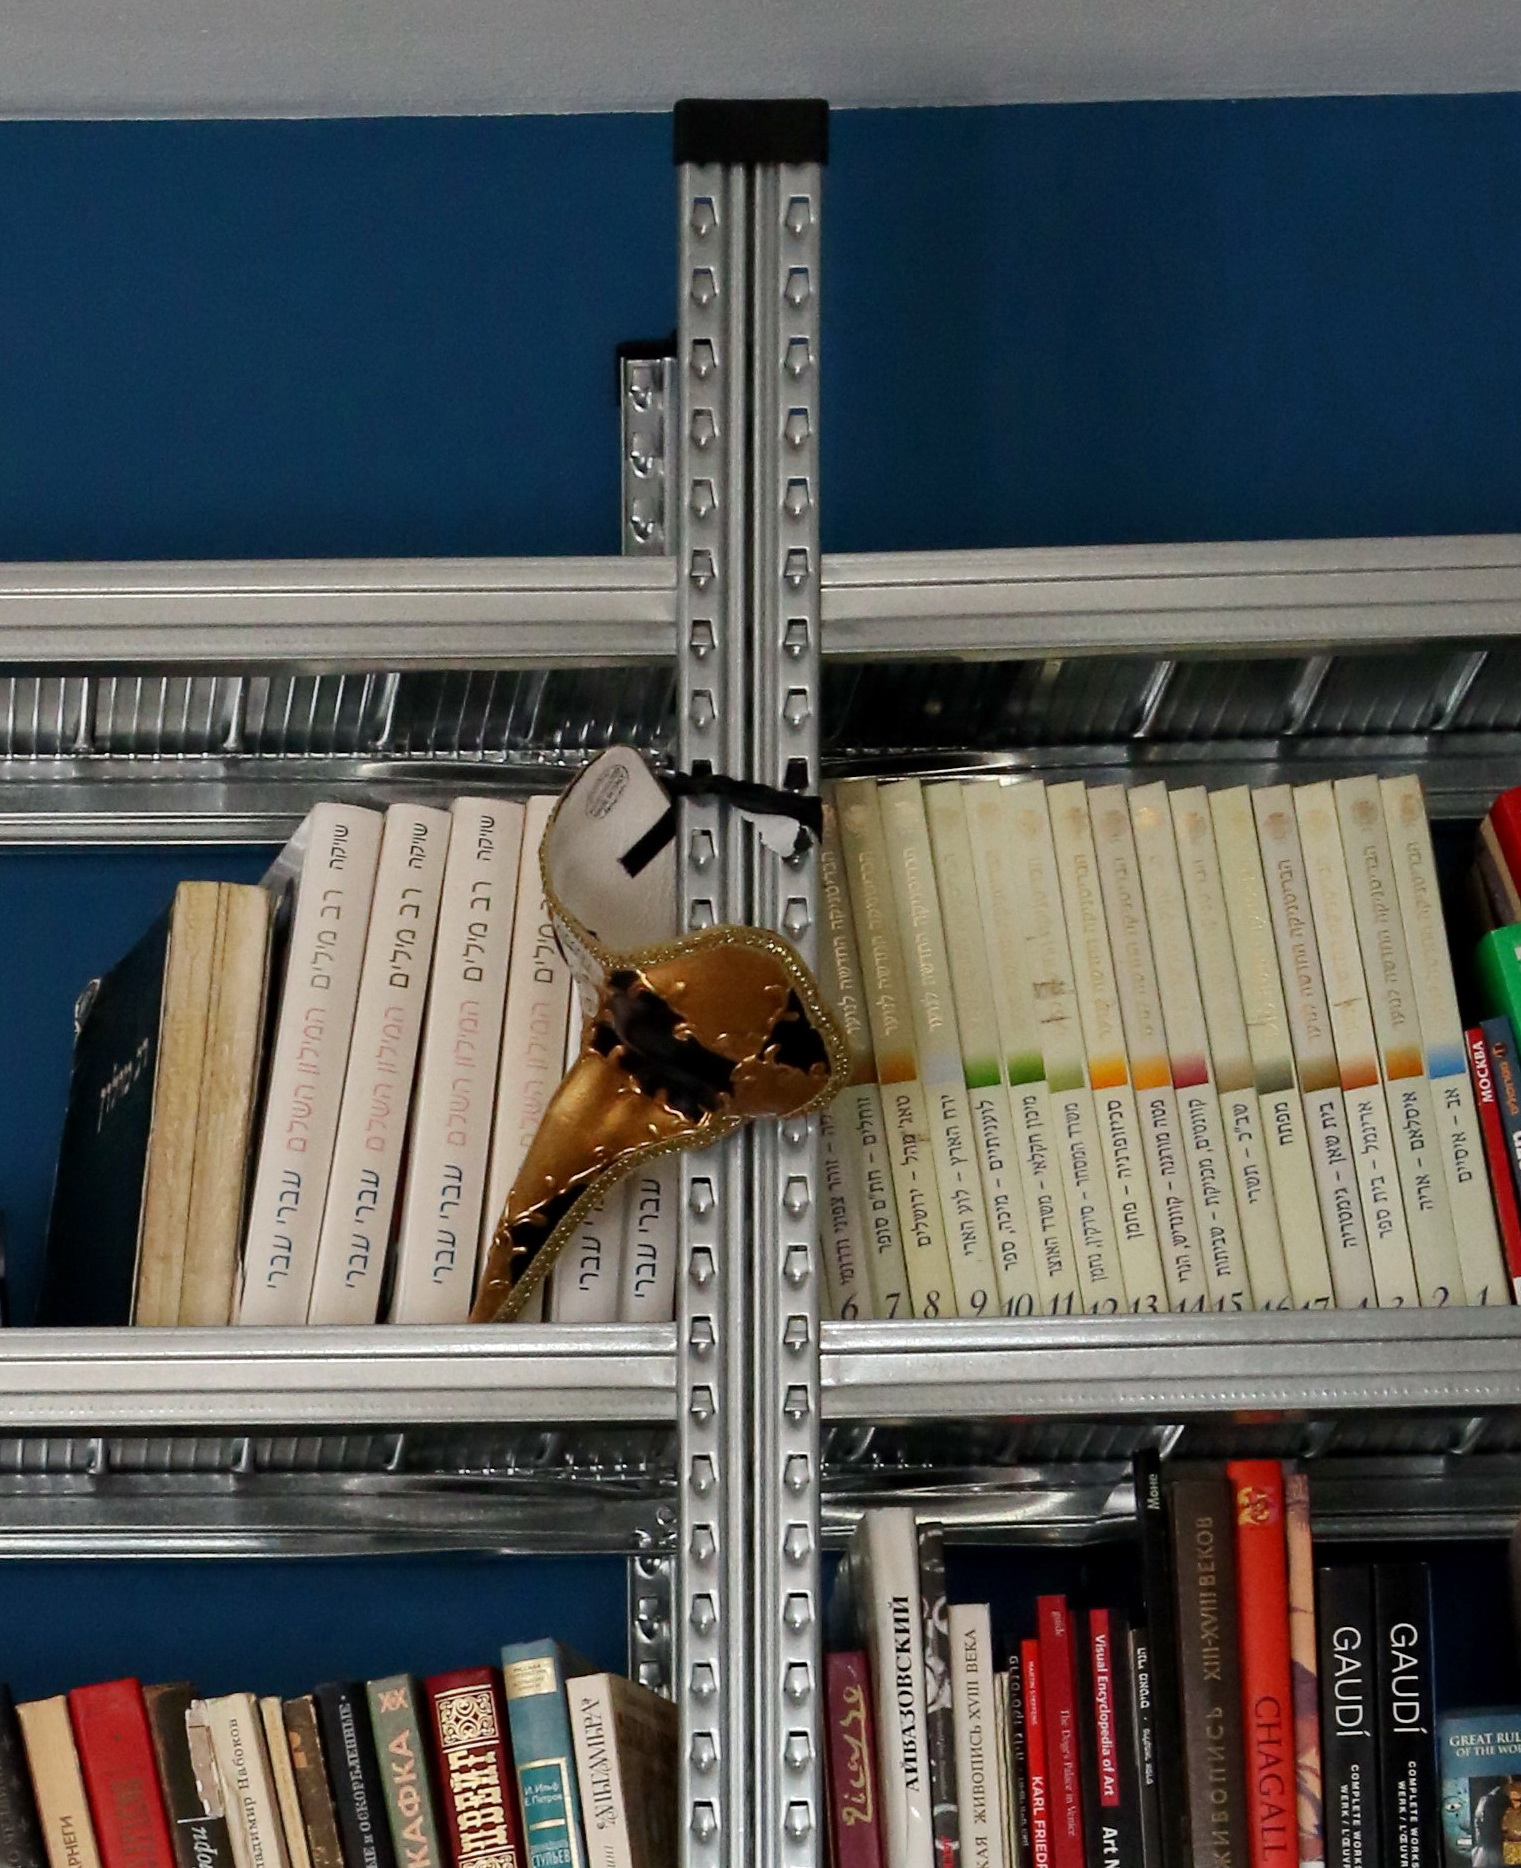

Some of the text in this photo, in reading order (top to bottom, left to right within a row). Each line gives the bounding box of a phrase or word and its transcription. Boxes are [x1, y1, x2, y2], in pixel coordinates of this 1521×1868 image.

[344, 888, 422, 1288] רב מילים המילון השלם עברי עברי
[433, 881, 493, 1284] רב מילים המילון השלם עברי עברי
[1446, 1088, 1461, 1108] אב
[1472, 1041, 1494, 1102] МОСКВА
[1274, 1102, 1293, 1146] מפתח
[1319, 1101, 1337, 1129] בית
[1402, 1091, 1424, 1150] איסלאם
[632, 1179, 661, 1298] עברי עברי
[1123, 1202, 1144, 1240] פחמן
[962, 1628, 980, 1673] ВЕКА
[1389, 1621, 1427, 1734] GAUDÍ
[889, 1595, 921, 1793] АЙВАЗОВСКИЙ
[1333, 1625, 1370, 1738] GAUDÍ
[1094, 1634, 1117, 1796] Visual Encyclopedia of Art
[1450, 1733, 1493, 1746] GREAT
[229, 1718, 249, 1790] Набоков
[967, 1724, 989, 1824] ЖИВОПИСЬ
[1253, 1695, 1288, 1861] CHAGALL
[1032, 1776, 1048, 1816] KARL
[1407, 1760, 1419, 1822] COMPLETE
[1102, 1826, 1121, 1855] Art
[1410, 1826, 1420, 1868] WORKS
